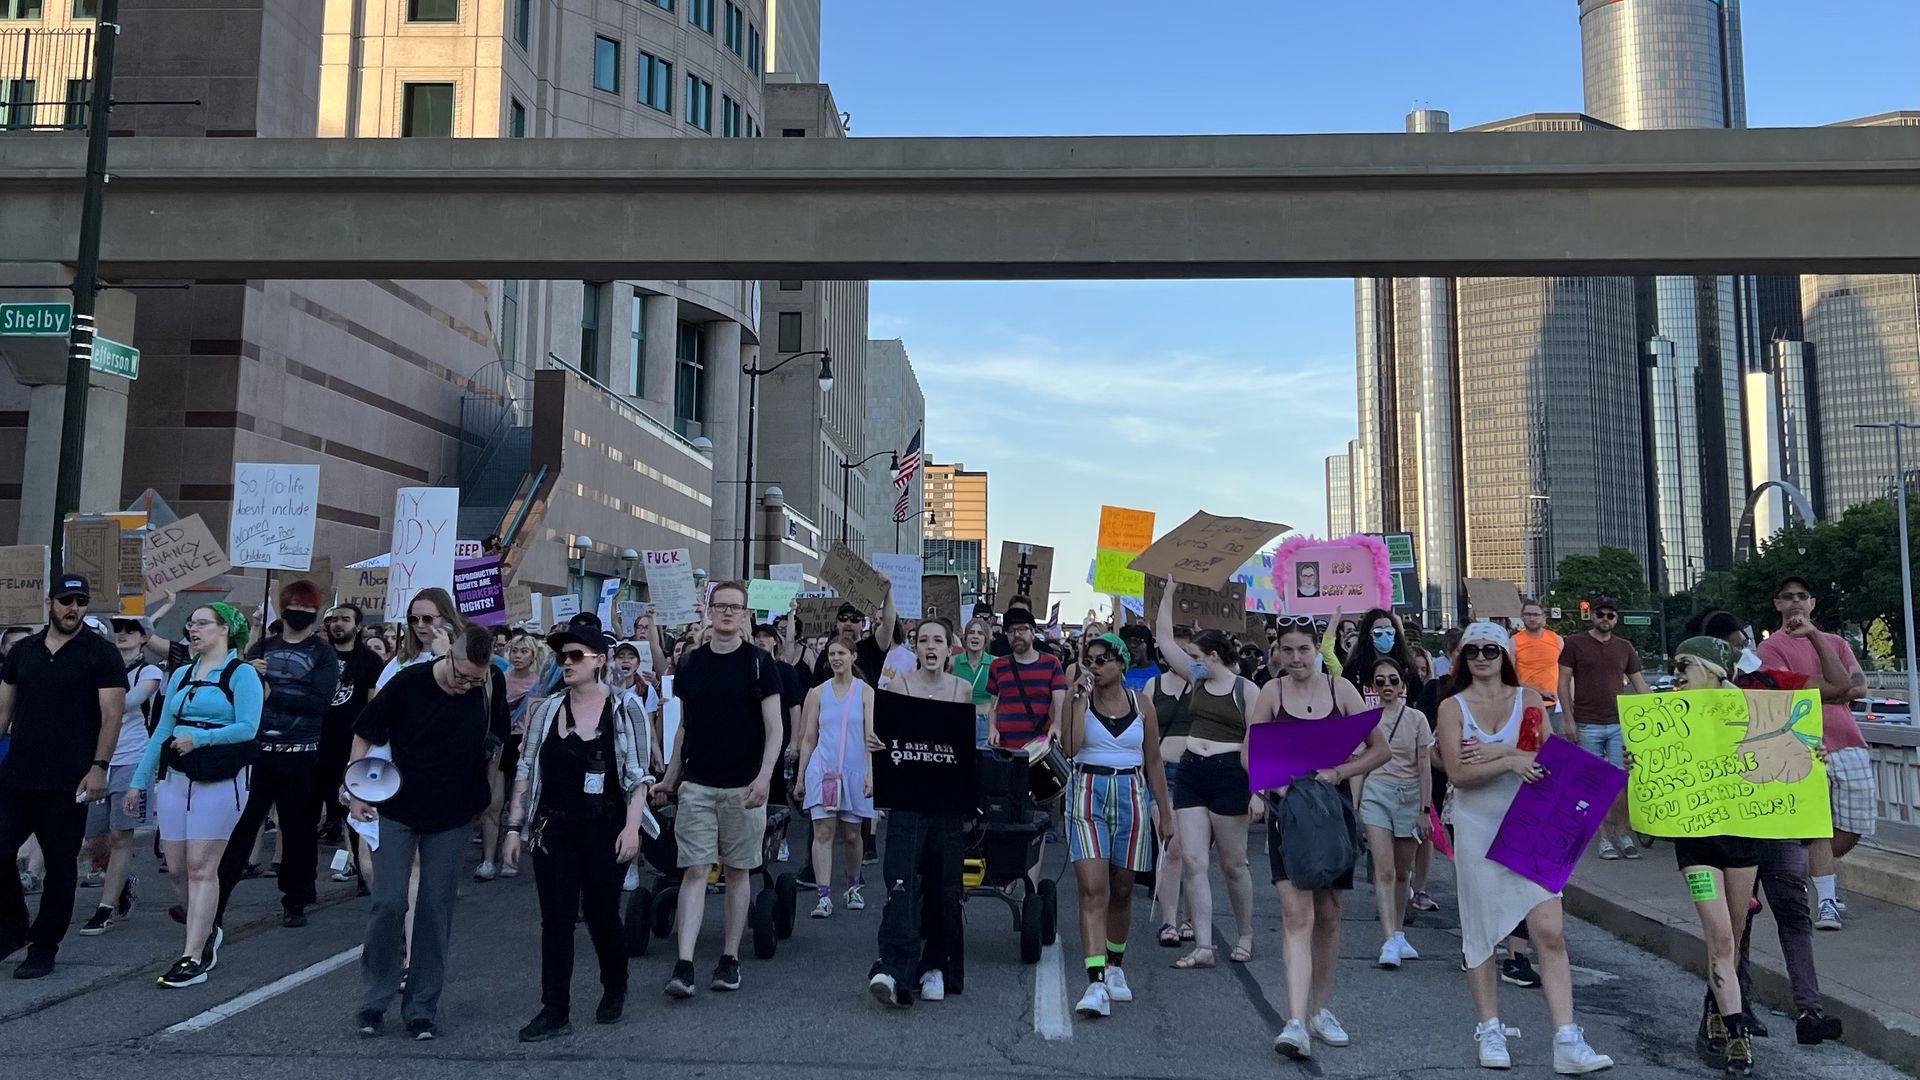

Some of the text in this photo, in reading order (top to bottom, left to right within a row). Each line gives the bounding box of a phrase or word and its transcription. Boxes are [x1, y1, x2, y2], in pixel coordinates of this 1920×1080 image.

[4, 309, 65, 332] Shelby
[131, 354, 138, 373] W
[271, 498, 310, 516] include
[239, 548, 272, 562] Children
[646, 551, 681, 565] FUCK
[146, 551, 222, 592] IOLENCE
[455, 567, 499, 583] REPRODUCTIVE
[456, 577, 491, 591] RIGHTS ARE
[460, 597, 495, 613] RIGHTS!
[1179, 599, 1243, 620] OPINION
[891, 739, 899, 749] I
[904, 742, 930, 752] am
[1633, 741, 1693, 784] YOUR
[1633, 751, 1759, 803] BALLS BEFORE
[1640, 783, 1755, 825] YOU DEMAND
[1676, 793, 1797, 834] THESE LAWS!
